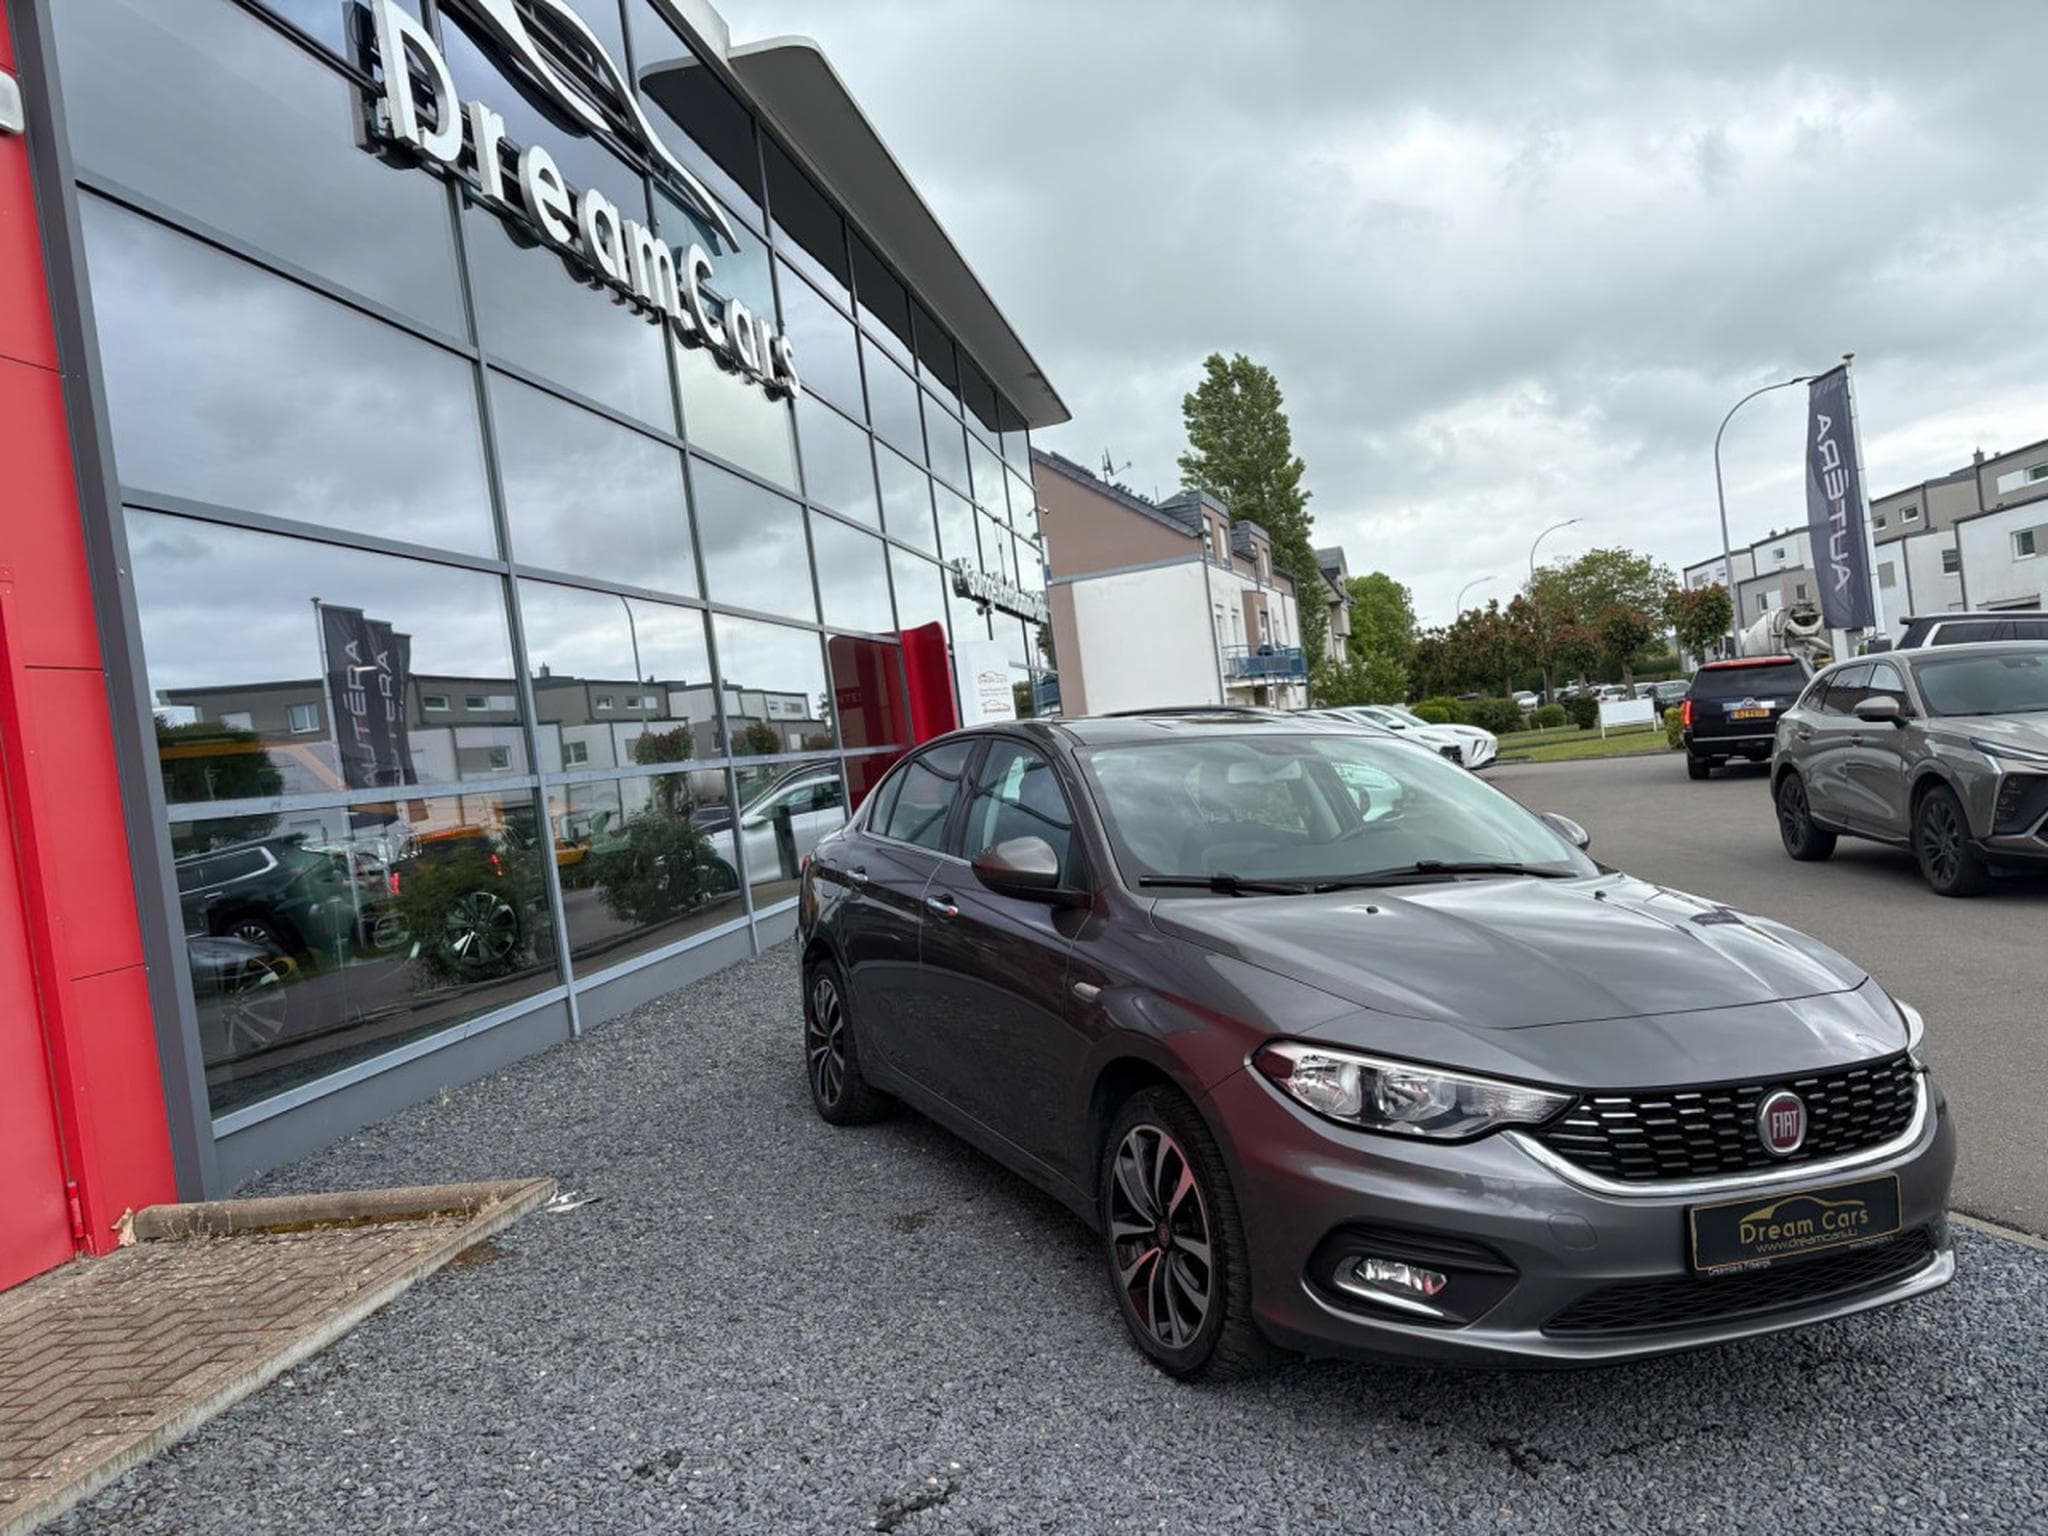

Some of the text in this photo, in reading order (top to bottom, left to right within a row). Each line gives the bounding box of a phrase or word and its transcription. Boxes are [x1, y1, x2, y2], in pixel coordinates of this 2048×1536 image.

[1772, 1110, 1798, 1140] FIAT
[1740, 1209, 1869, 1245] Dream Cars
